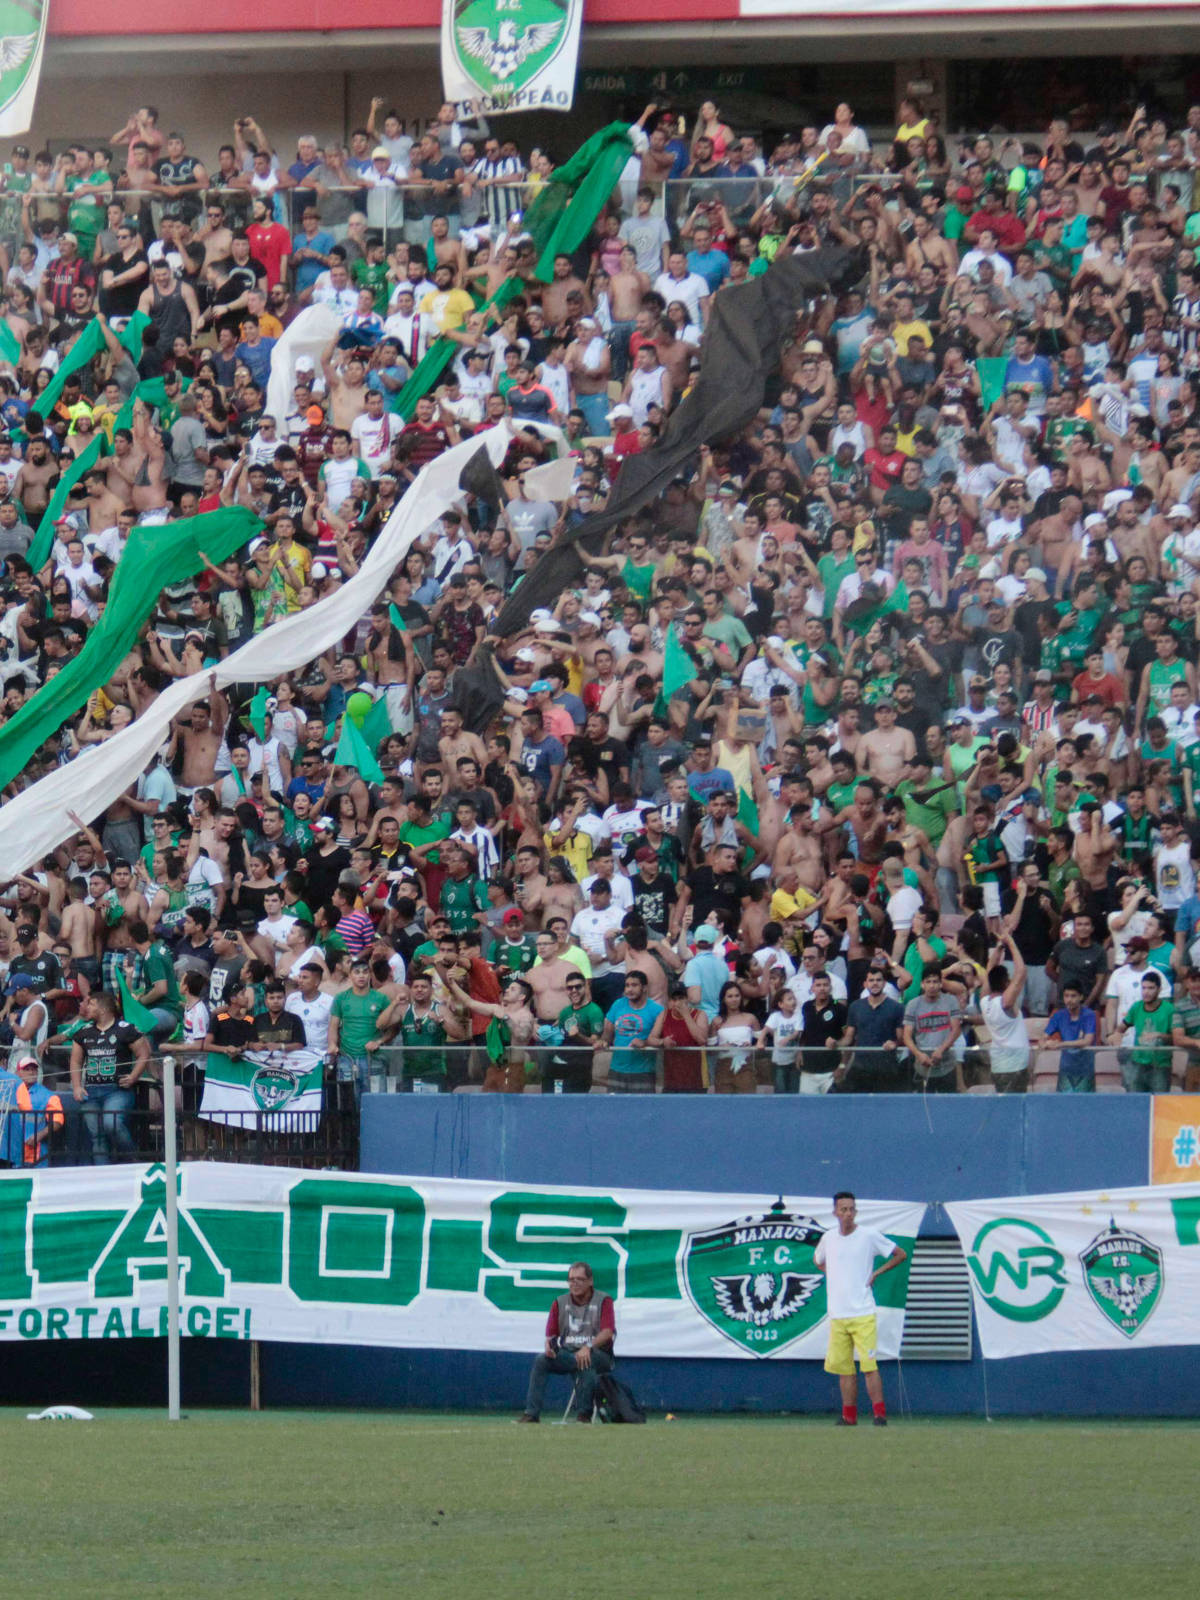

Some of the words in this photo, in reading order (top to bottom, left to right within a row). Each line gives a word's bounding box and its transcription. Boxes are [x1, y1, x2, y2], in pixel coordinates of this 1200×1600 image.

[734, 1225, 808, 1246] MANAUS
[1096, 1240, 1143, 1258] MANAUS
[745, 1329, 779, 1341] 2013
